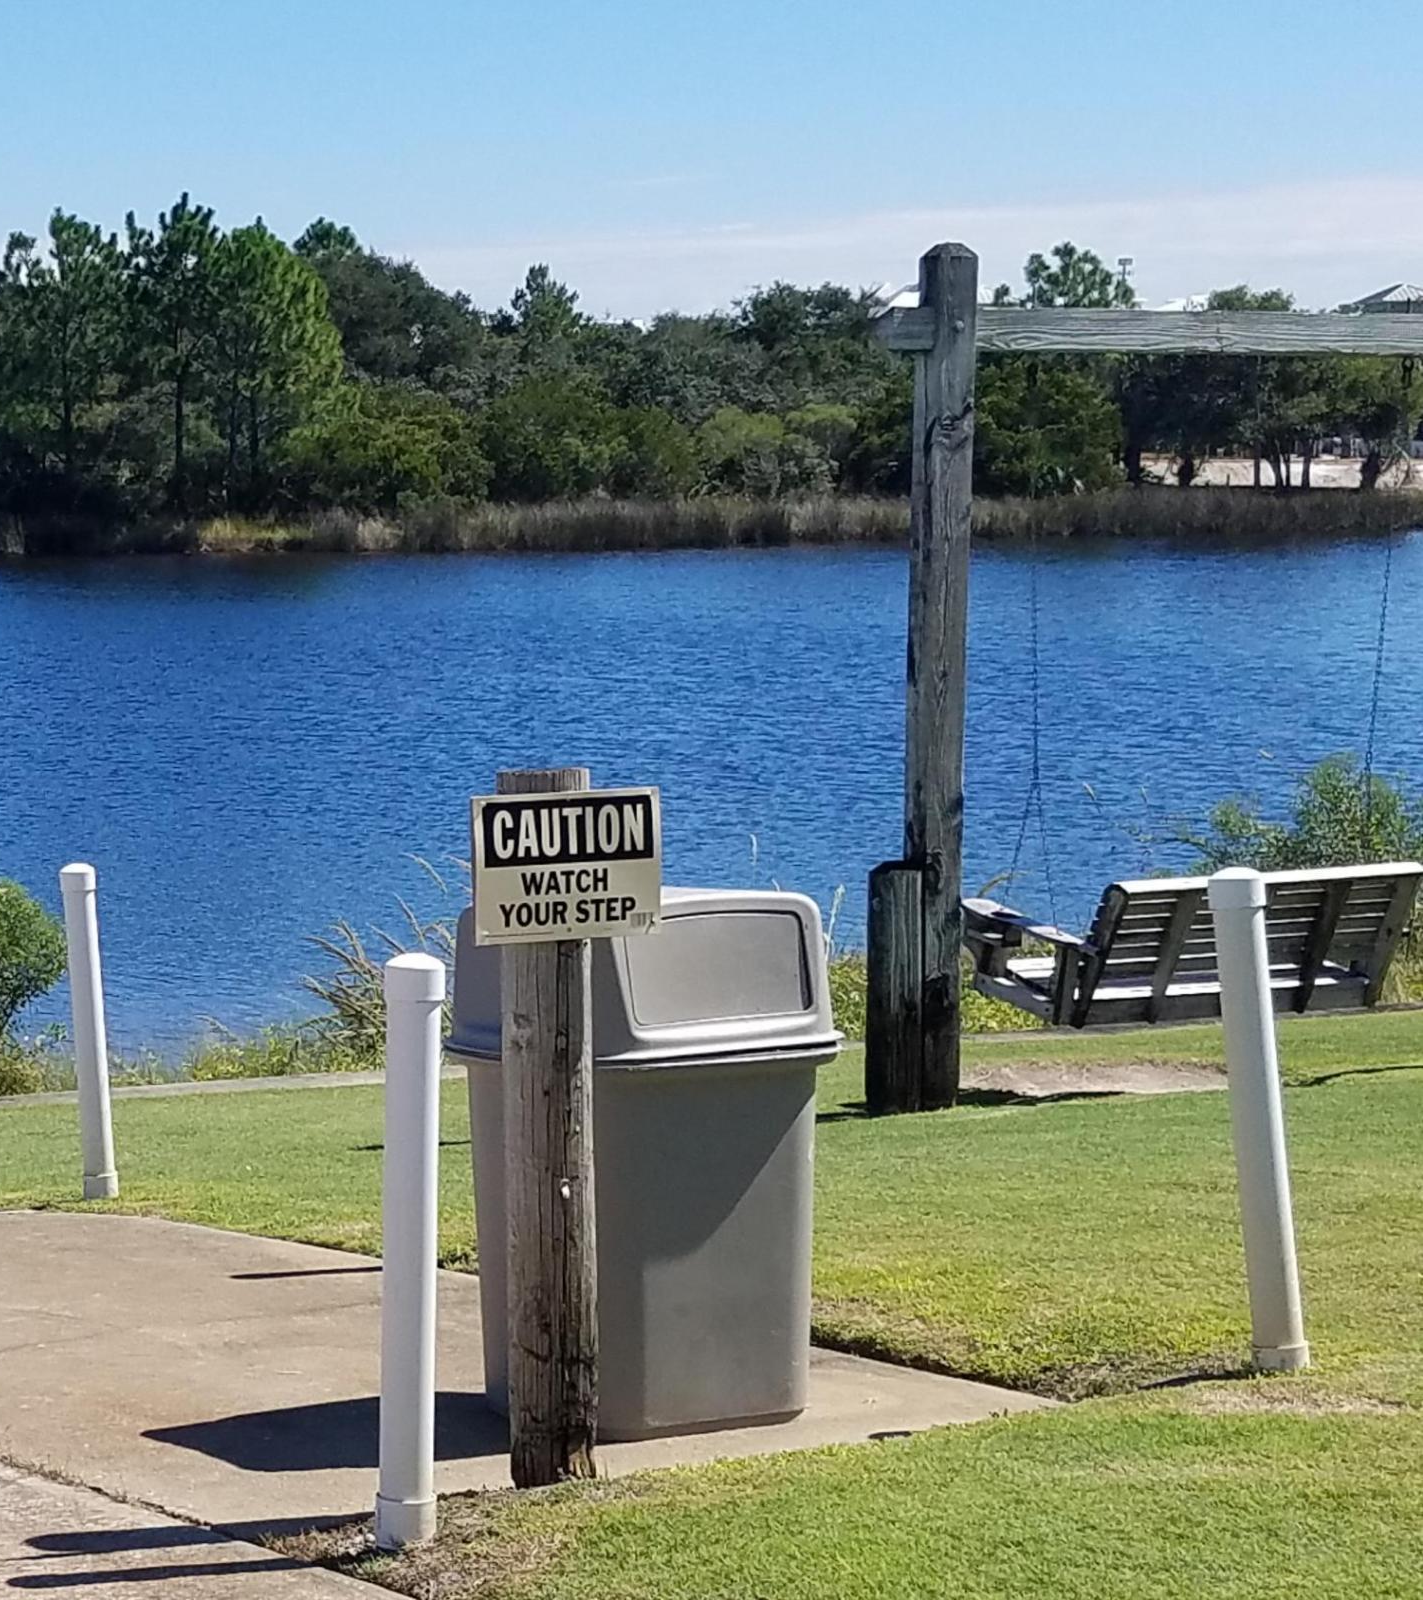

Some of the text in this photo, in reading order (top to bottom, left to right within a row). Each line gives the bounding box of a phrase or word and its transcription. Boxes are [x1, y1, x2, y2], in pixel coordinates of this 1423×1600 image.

[493, 804, 644, 859] CAUTION
[521, 868, 608, 896] WATCH
[499, 897, 636, 927] YOUR STEP
